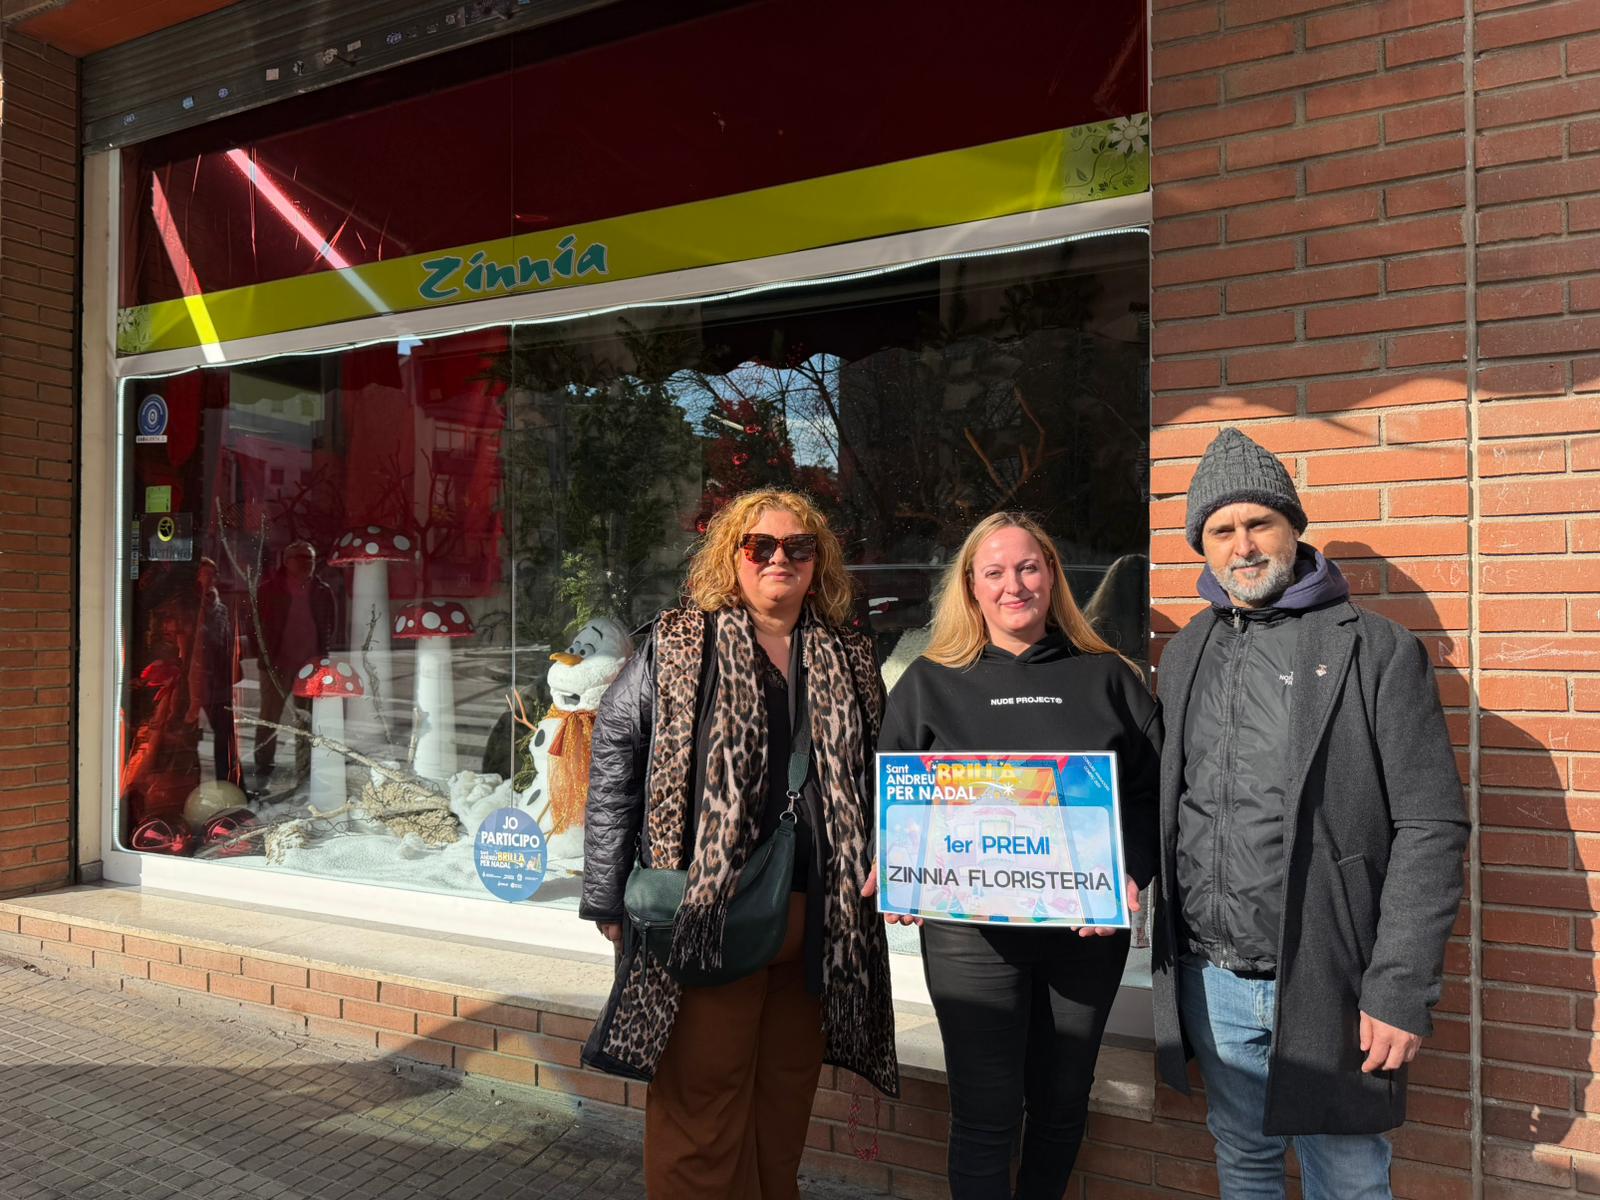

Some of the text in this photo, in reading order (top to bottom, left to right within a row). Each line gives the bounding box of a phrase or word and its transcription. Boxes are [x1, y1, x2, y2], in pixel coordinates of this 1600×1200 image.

[990, 697, 1014, 706] NUDE
[886, 764, 909, 774] Sant
[886, 763, 1019, 785] ANDREU BRILLA
[887, 786, 977, 800] PER NADAL
[502, 815, 519, 830] JO
[480, 830, 540, 849] PARTICIPO
[944, 835, 1050, 855] 1er PREMI
[497, 851, 526, 865] BRILLA
[888, 865, 1112, 891] ZINNIA FLORISTERIA
